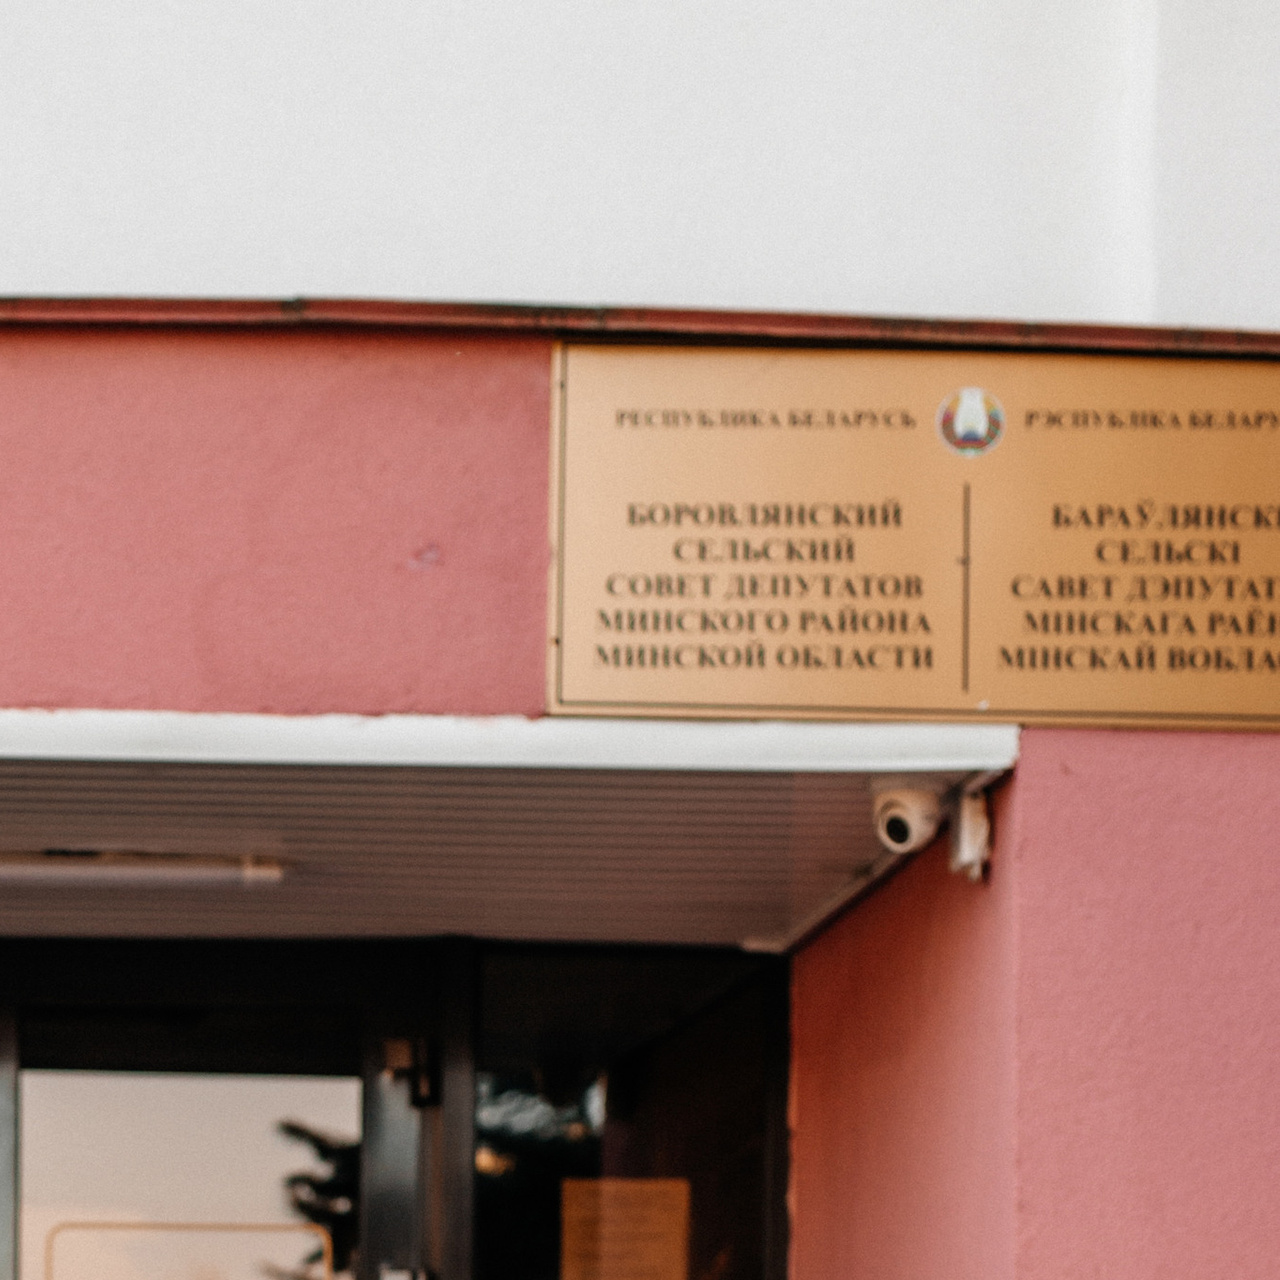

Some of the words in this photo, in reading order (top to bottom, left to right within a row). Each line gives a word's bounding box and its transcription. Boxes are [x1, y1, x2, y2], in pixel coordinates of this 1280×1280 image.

[616, 410, 782, 430] РЕСПУБЛИКА
[788, 410, 918, 431] БЕЛАРУСЬ
[1189, 411, 1280, 432] БЕЛАРУ
[628, 500, 904, 530] БОРОВЛЯНСКИЙ
[674, 536, 856, 564] СЕЛЬСКИЙ
[1096, 538, 1241, 566] СЕЛЬСКІ
[606, 575, 717, 599] СОВЕТ
[728, 575, 925, 601] ДЕПУТАТОВ
[1011, 576, 1119, 601] САВЕТ
[1126, 577, 1280, 602] ДЭПУТАТ
[598, 610, 790, 634] МИНСКОГО
[800, 609, 933, 636] РАЙОНА
[1025, 611, 1197, 637] МІНСКАГА
[596, 643, 767, 670] МИНСКОЙ
[776, 646, 935, 671] ОБЛАСТИ
[1000, 644, 1158, 672] МІНСКАЙ
[1168, 648, 1280, 674] ВОБЛА
